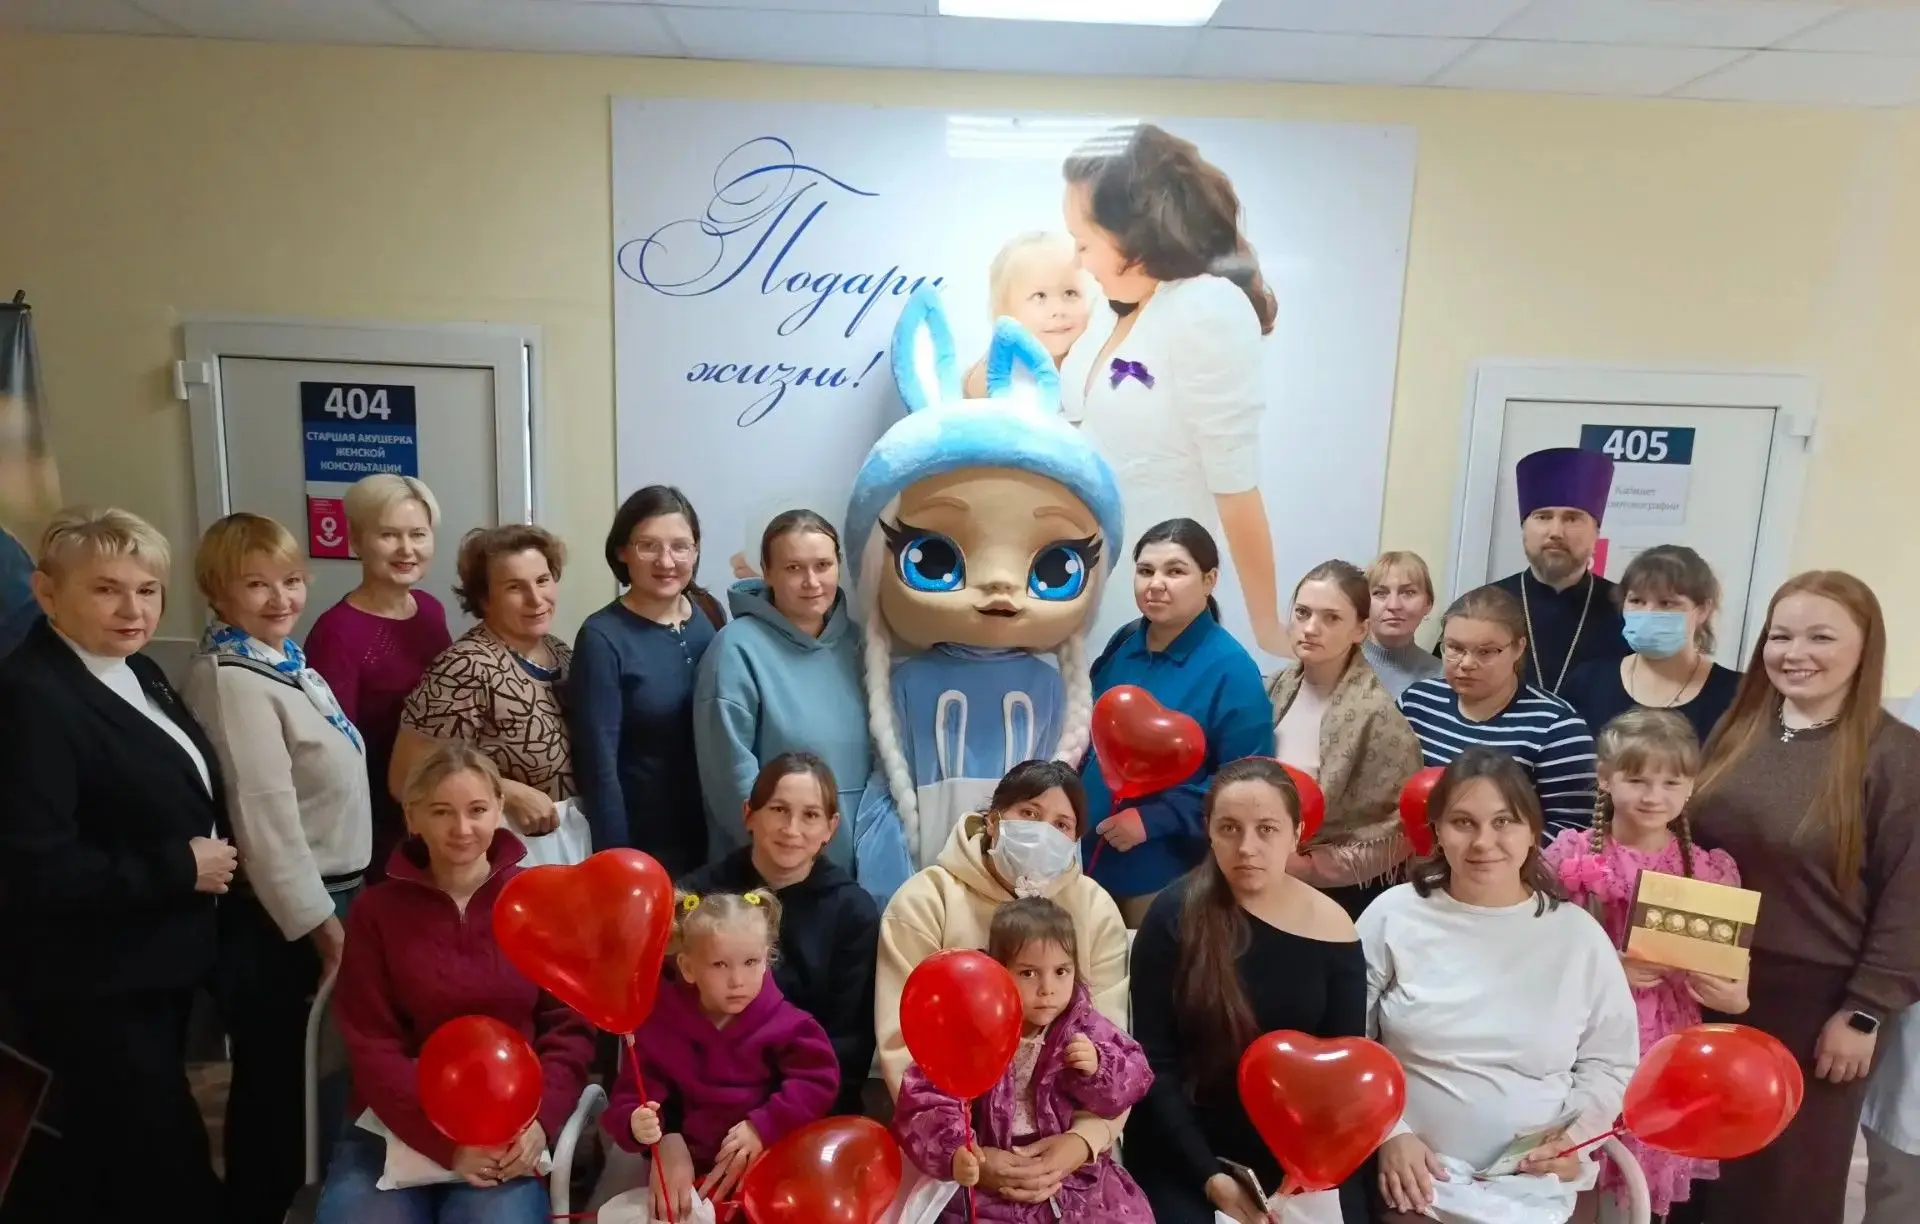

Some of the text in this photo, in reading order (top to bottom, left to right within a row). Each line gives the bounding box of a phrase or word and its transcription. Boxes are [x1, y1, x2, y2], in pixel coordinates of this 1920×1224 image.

[686, 351, 884, 428] жизнь!
[324, 387, 391, 421] 404
[306, 431, 413, 445] СТАРШАЯ АКУШЕРКА
[1602, 429, 1669, 462] 405
[336, 447, 385, 458] ЖЕНСКОЙ
[320, 461, 402, 473] КОНСУЛЬТАЦИИ
